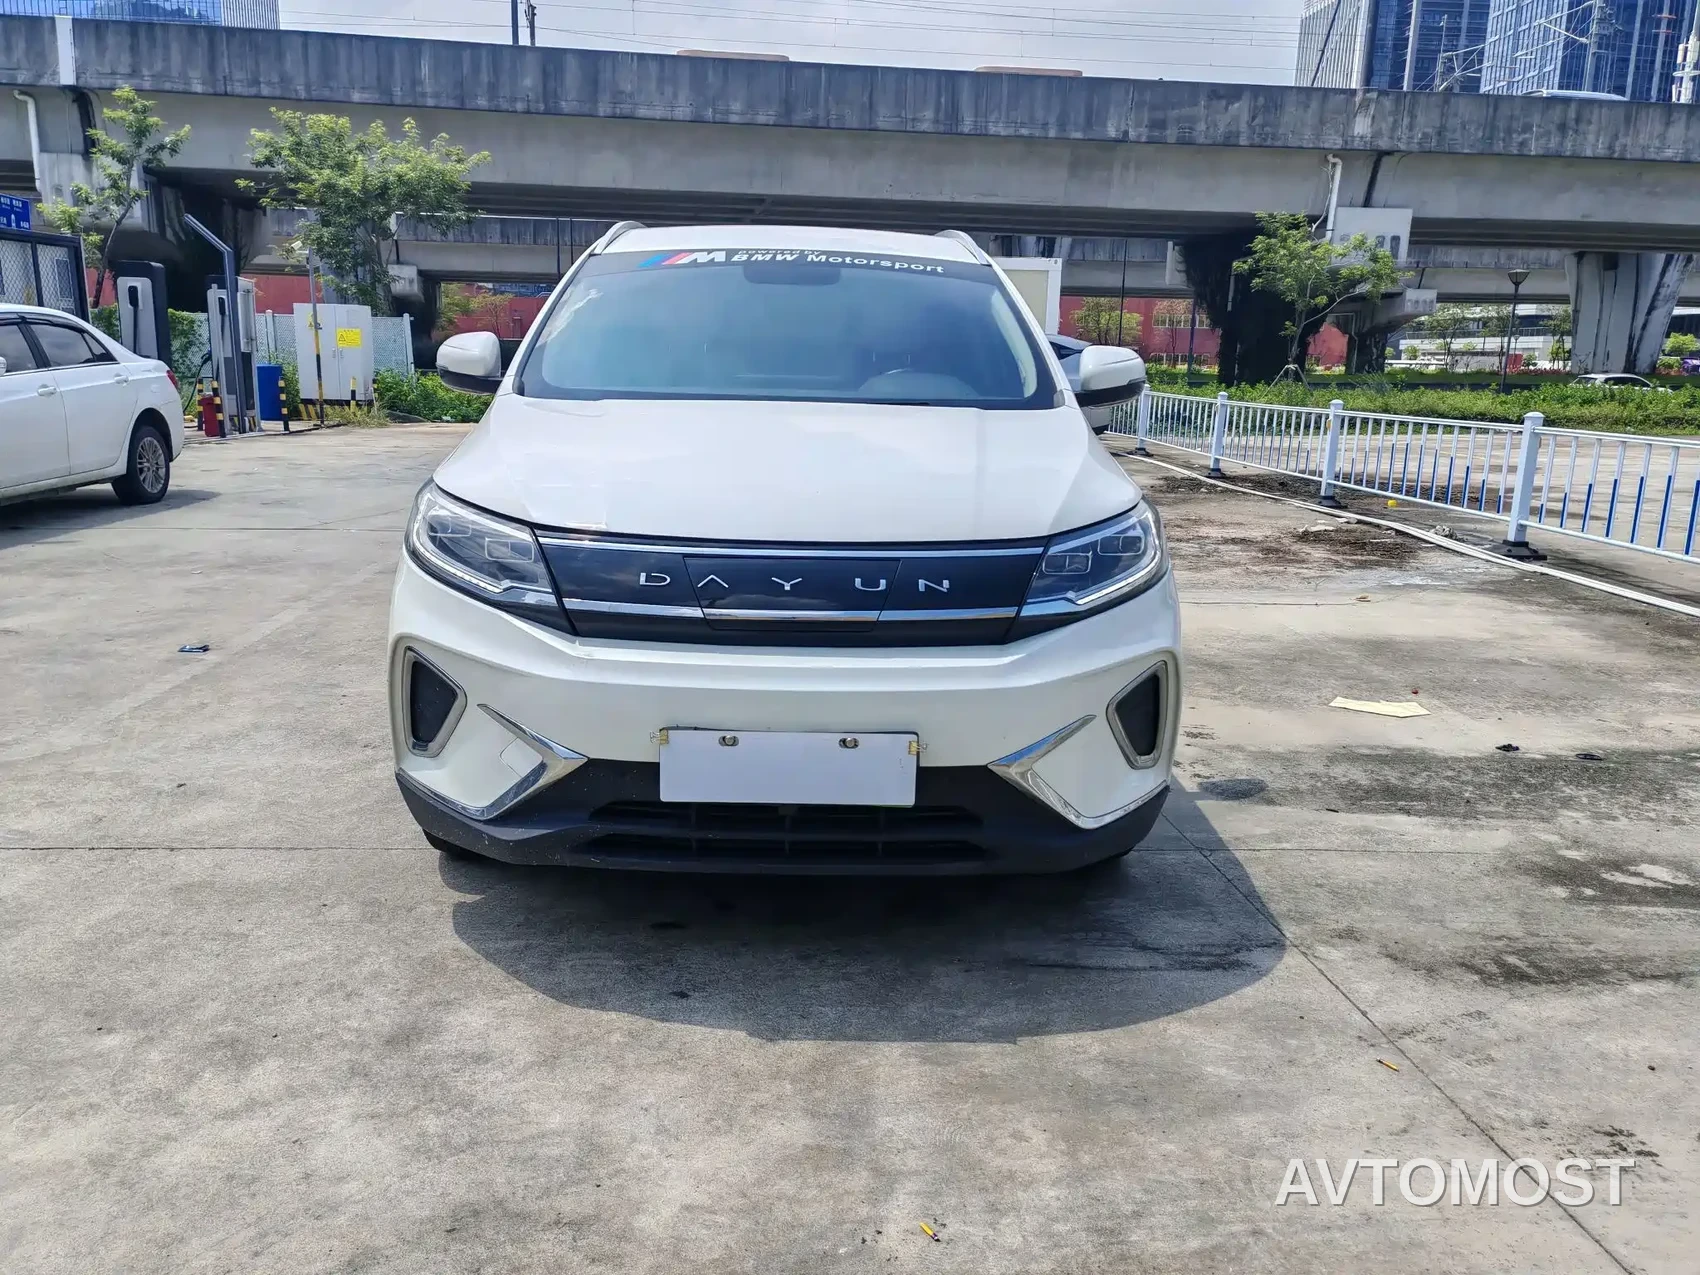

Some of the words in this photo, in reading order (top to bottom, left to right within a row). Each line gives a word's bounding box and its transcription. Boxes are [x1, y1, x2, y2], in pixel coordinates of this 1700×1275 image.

[730, 253, 800, 262] BMW
[806, 254, 945, 273] Motorsport
[639, 572, 950, 593] DAYUN
